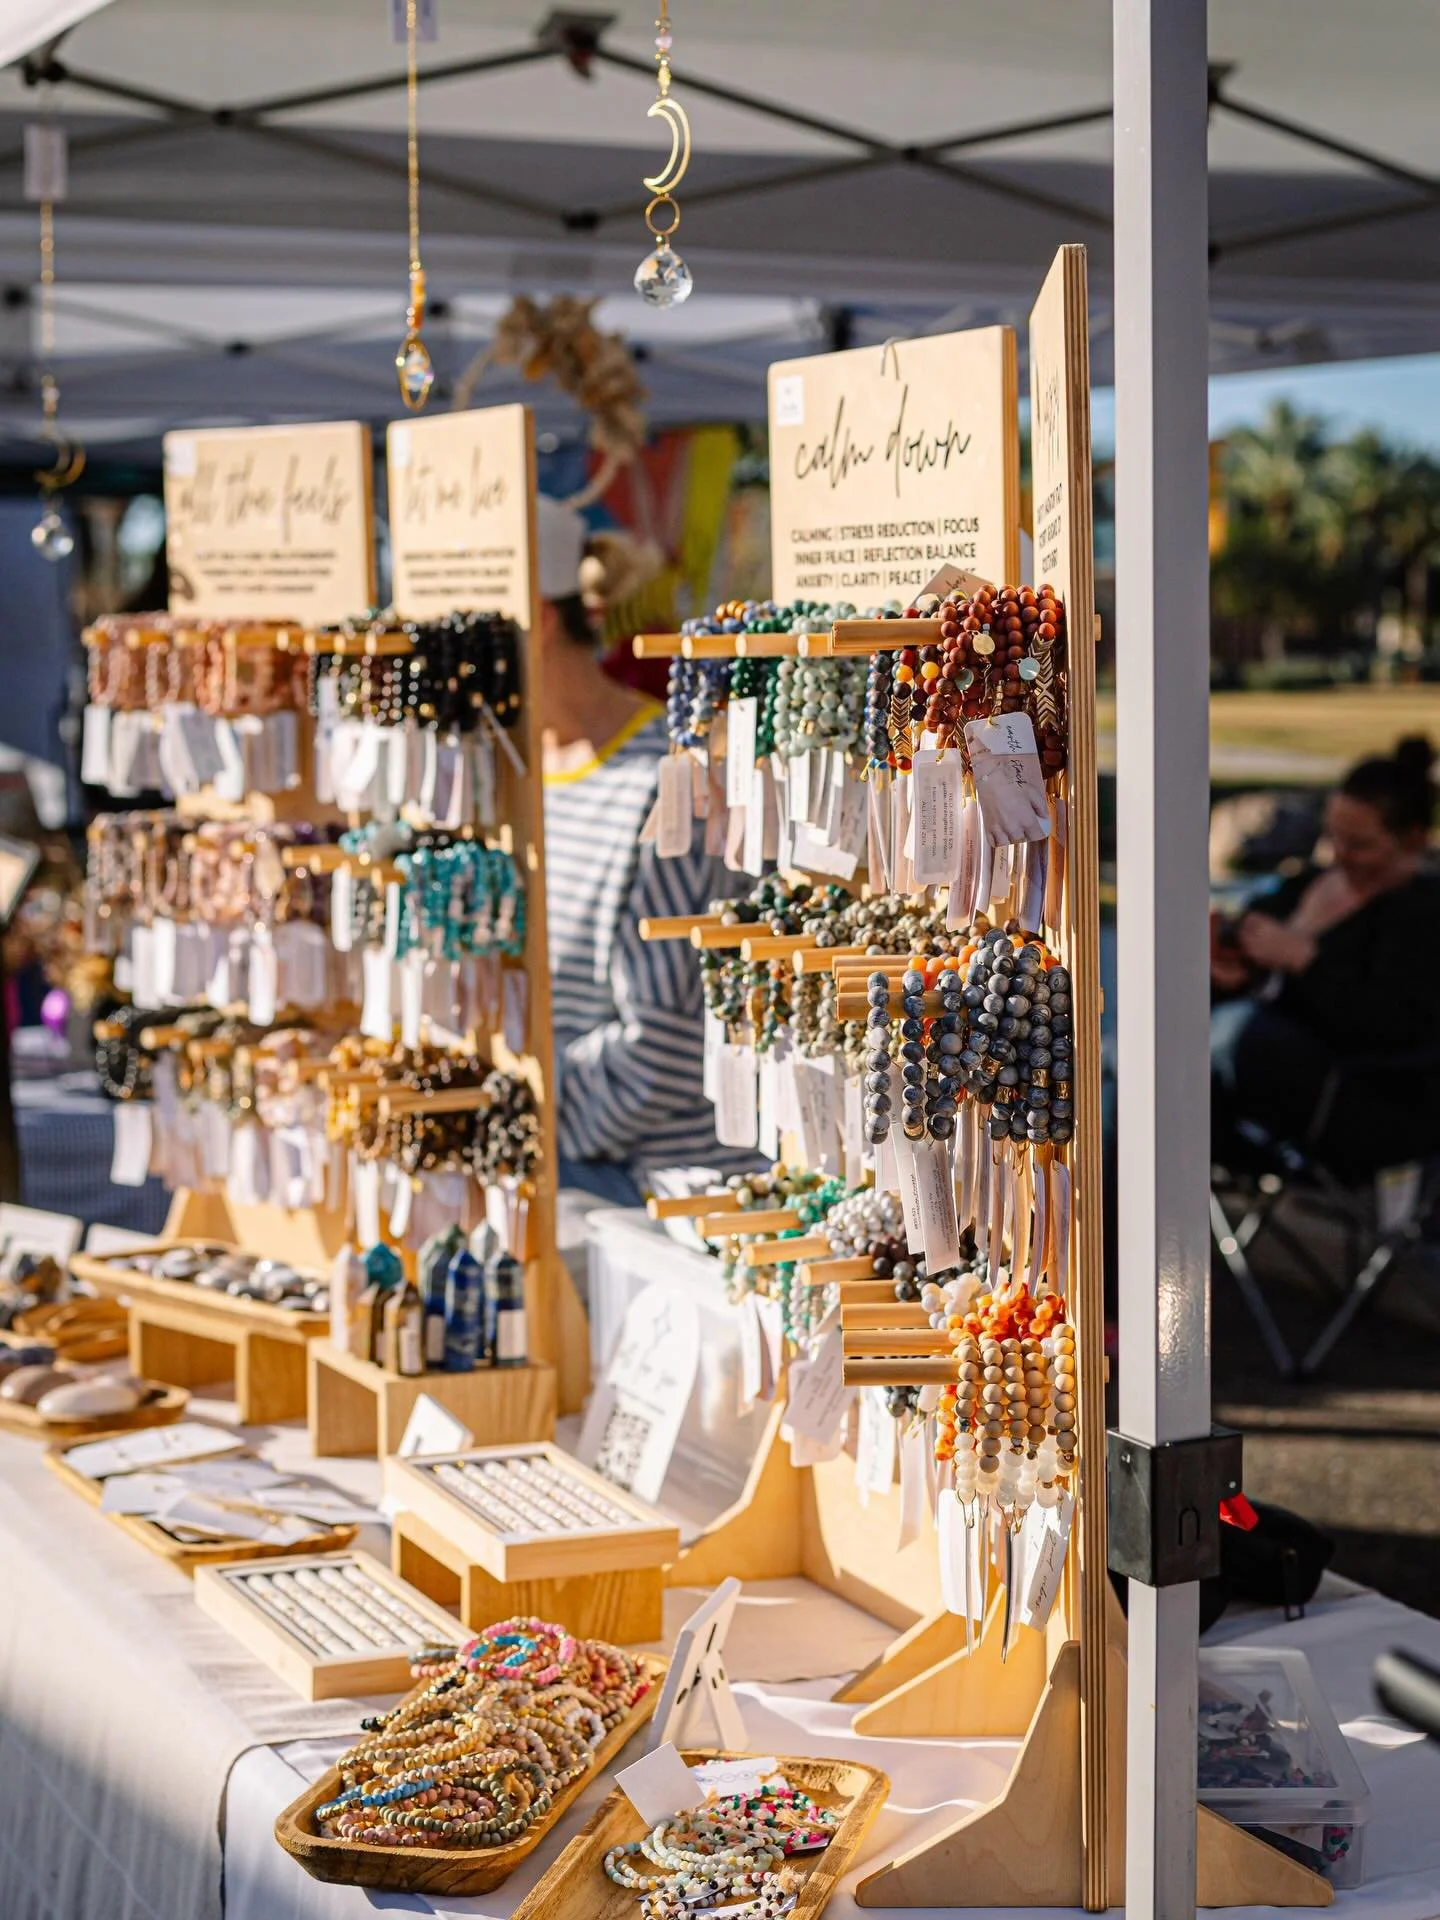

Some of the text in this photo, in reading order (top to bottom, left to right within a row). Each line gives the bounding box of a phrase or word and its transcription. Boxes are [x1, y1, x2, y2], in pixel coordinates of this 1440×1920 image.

[793, 383, 972, 499] calm down
[791, 517, 979, 543] CALMING STRESS REDUCTION FOCUS
[795, 542, 977, 565] INNER PEACE REFLECTION BALANCE
[796, 573, 833, 588] ANXIETY
[842, 571, 881, 587] CLARITY
[889, 570, 922, 586] PEACE
[1010, 758, 1025, 789] stack
